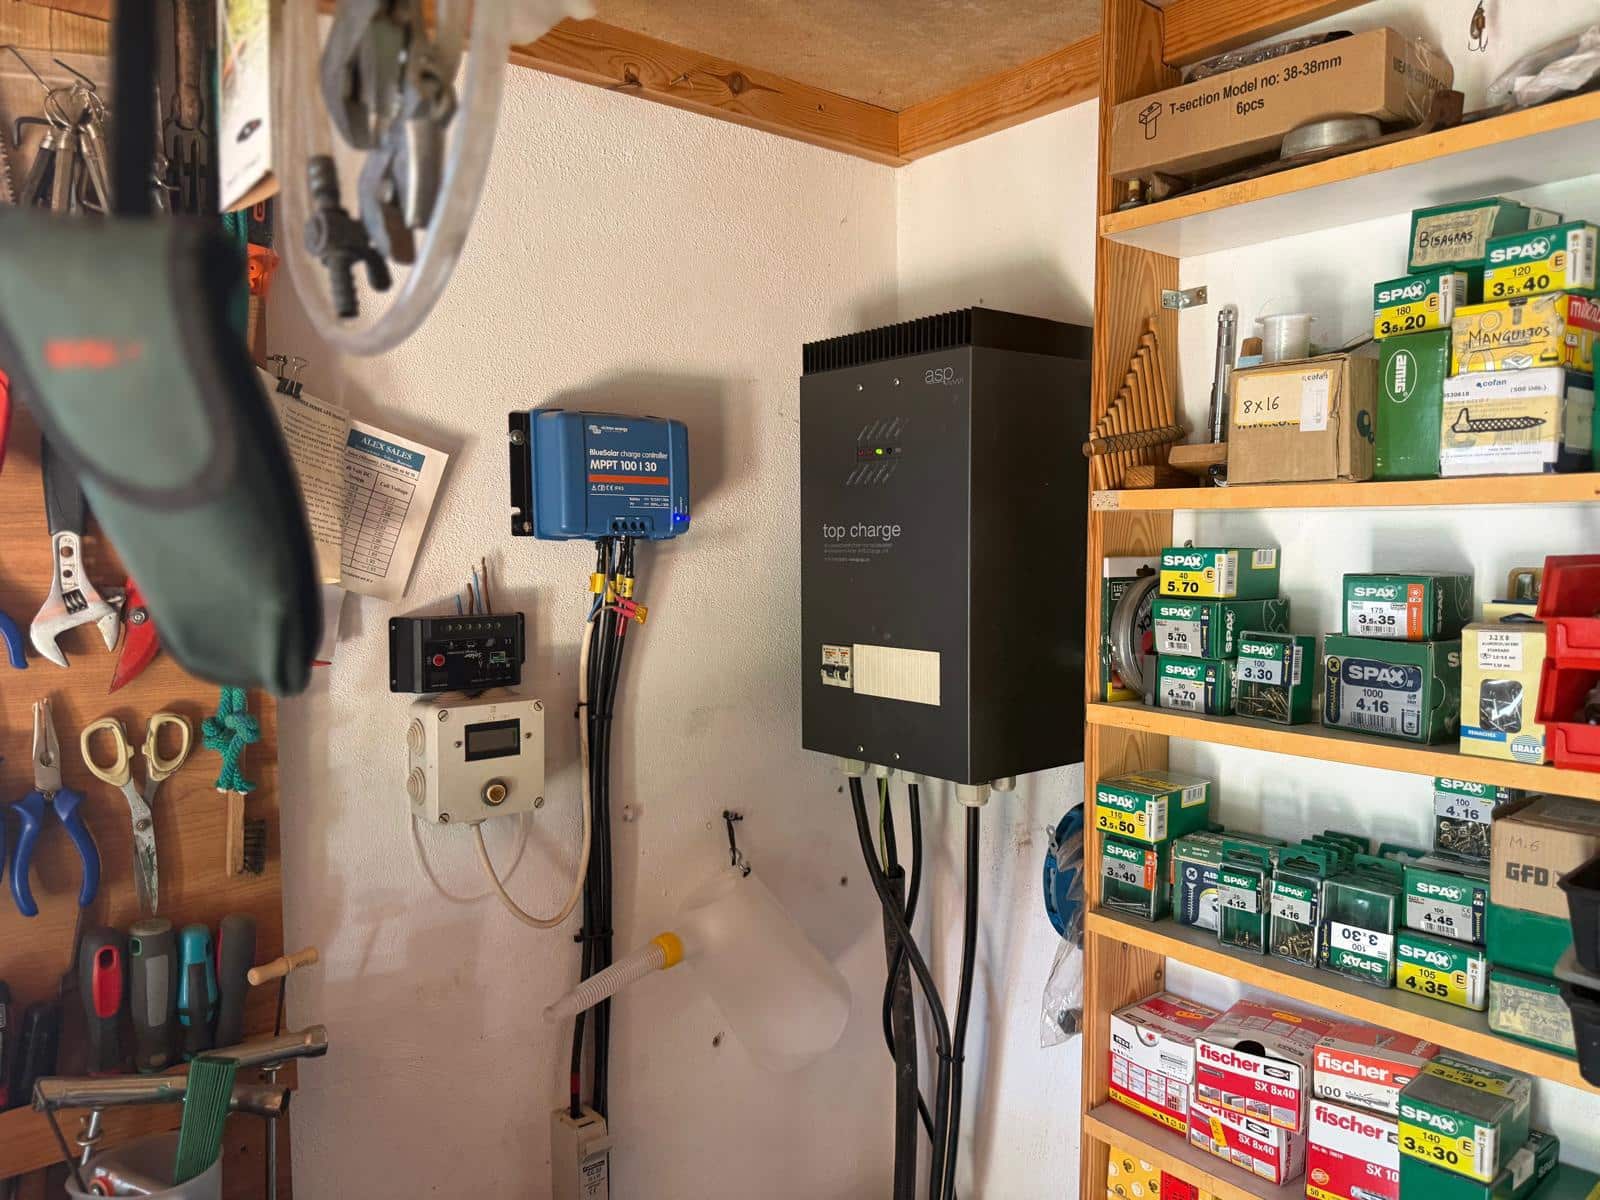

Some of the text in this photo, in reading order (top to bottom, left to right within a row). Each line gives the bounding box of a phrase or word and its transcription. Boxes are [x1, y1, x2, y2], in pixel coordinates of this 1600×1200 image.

[1169, 55, 1342, 115] T-section Model no: 38-38mm
[1236, 98, 1265, 115] 6pcs
[1490, 237, 1548, 263] SPAX
[1555, 256, 1563, 266] E
[1513, 265, 1531, 277] 120
[1378, 283, 1424, 303] SPAX
[1429, 297, 1437, 307] E
[1395, 305, 1411, 316] 180
[925, 367, 954, 384] asp
[1483, 379, 1507, 387] cofan
[361, 436, 386, 451] ALEX
[385, 446, 412, 460] SALES
[589, 448, 668, 460] BlueSolar charge controller
[590, 459, 619, 470] MPPT
[620, 460, 637, 471] 100
[645, 461, 657, 472] 30
[823, 522, 901, 541] top charge
[1163, 555, 1201, 567] SPAX
[1207, 570, 1213, 578] E
[1354, 587, 1395, 598] SPAX
[1160, 607, 1191, 617] SPAX
[1225, 612, 1233, 653] SPAX
[1242, 644, 1273, 656] SPAX
[1165, 665, 1196, 676] SPAX
[1348, 665, 1405, 685] SPAX
[1362, 688, 1383, 699] 1000
[1512, 744, 1542, 754] BRALO
[1440, 778, 1483, 793] SPAX
[1098, 791, 1133, 809] SPAX
[1456, 798, 1470, 807] 100
[1110, 811, 1122, 819] 110
[1106, 845, 1137, 860] SPAX
[1223, 875, 1249, 887] SPAX
[1505, 862, 1549, 887] GFD
[1278, 885, 1304, 897] SPAX
[1416, 882, 1459, 899] SPAX
[1352, 943, 1366, 952] 100
[1342, 953, 1383, 973] SPAX
[1399, 944, 1449, 968] SPAX
[1419, 968, 1436, 979] 105
[1456, 974, 1464, 984] E
[1199, 1043, 1260, 1073] fischer
[1317, 1051, 1389, 1080] fischer
[1439, 1057, 1491, 1077] SPAX
[1254, 1080, 1295, 1099] SX 8x40
[1318, 1084, 1341, 1098] 100
[1315, 1105, 1384, 1140] fischer
[1400, 1105, 1455, 1133] SPAX
[1238, 1133, 1275, 1155] SX 8x40
[1422, 1131, 1441, 1144] 140
[1462, 1140, 1471, 1152] E
[1366, 1163, 1382, 1178] SX
